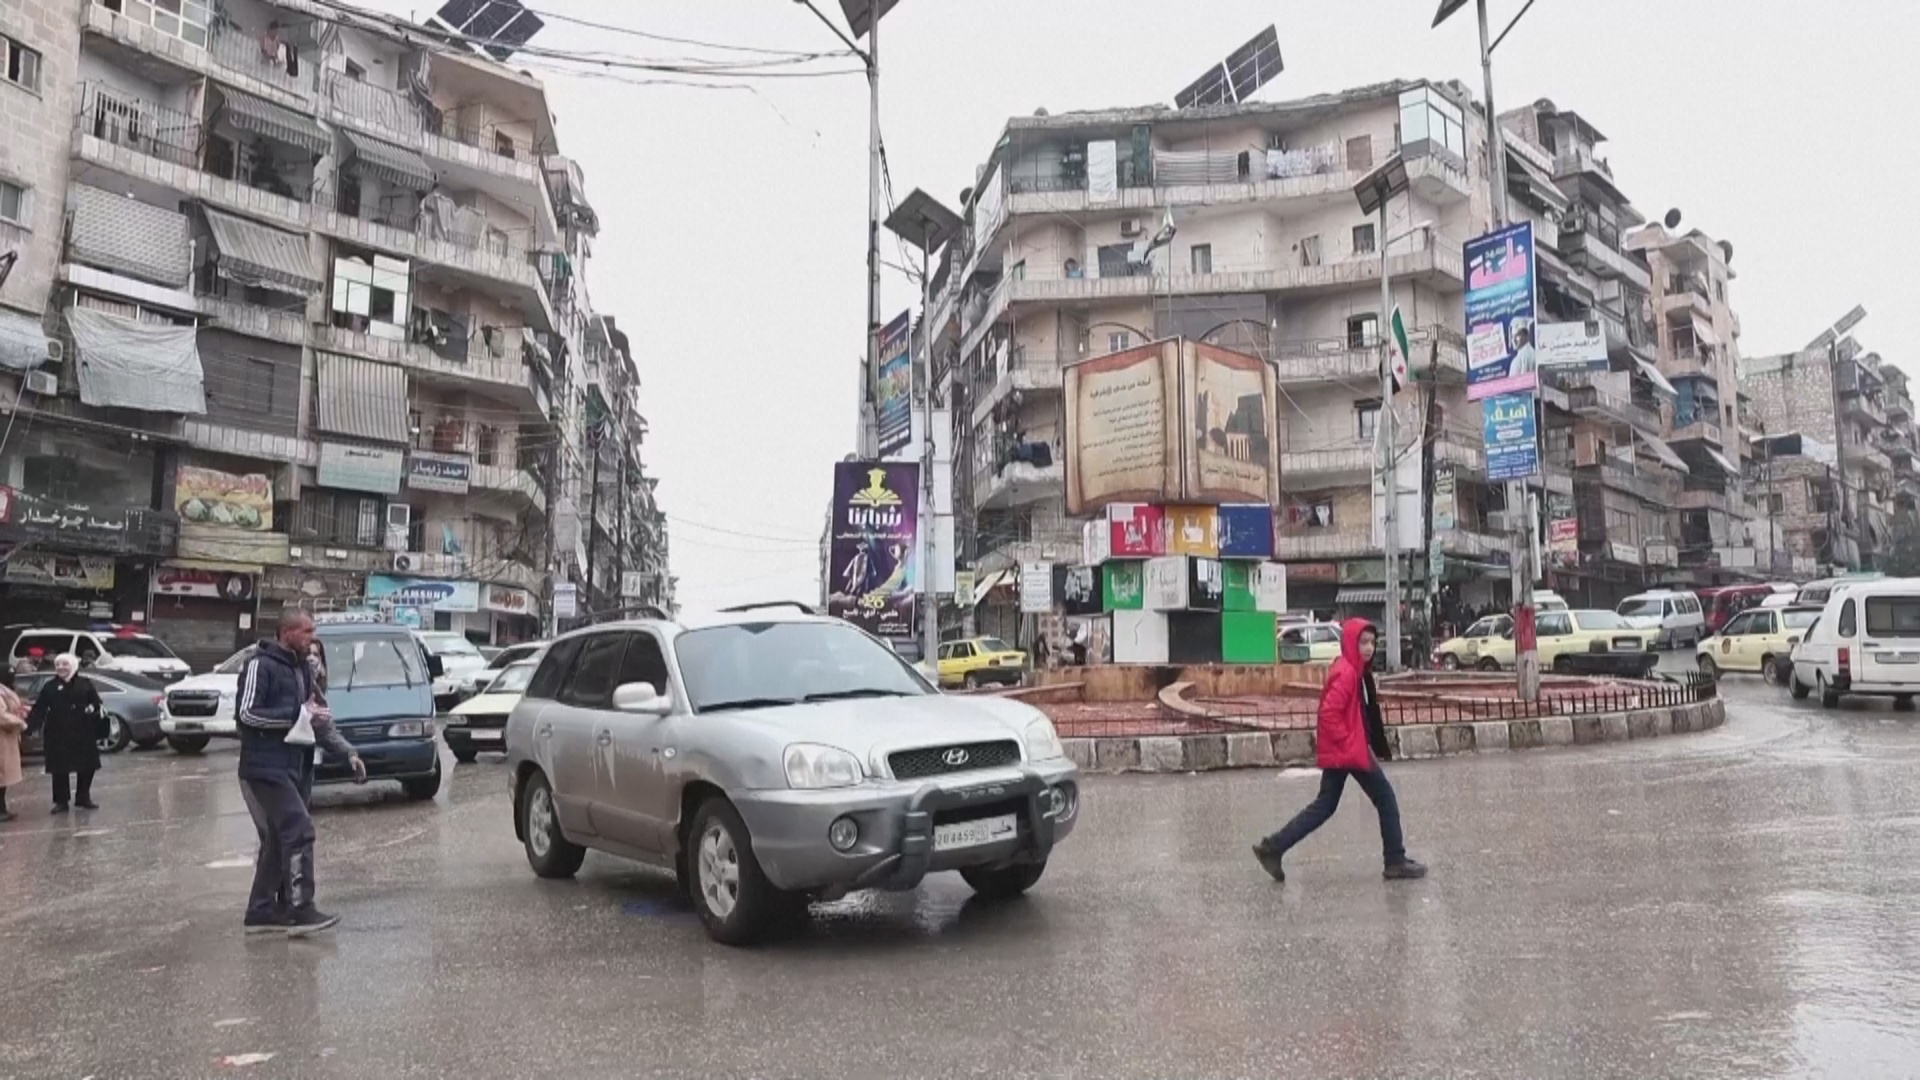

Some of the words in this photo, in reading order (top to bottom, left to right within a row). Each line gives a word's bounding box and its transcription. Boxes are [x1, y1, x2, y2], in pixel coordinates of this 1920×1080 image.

[848, 505, 902, 530] شبابنا
[394, 588, 449, 601] SAMSUNG
[990, 820, 1013, 839] حلب
